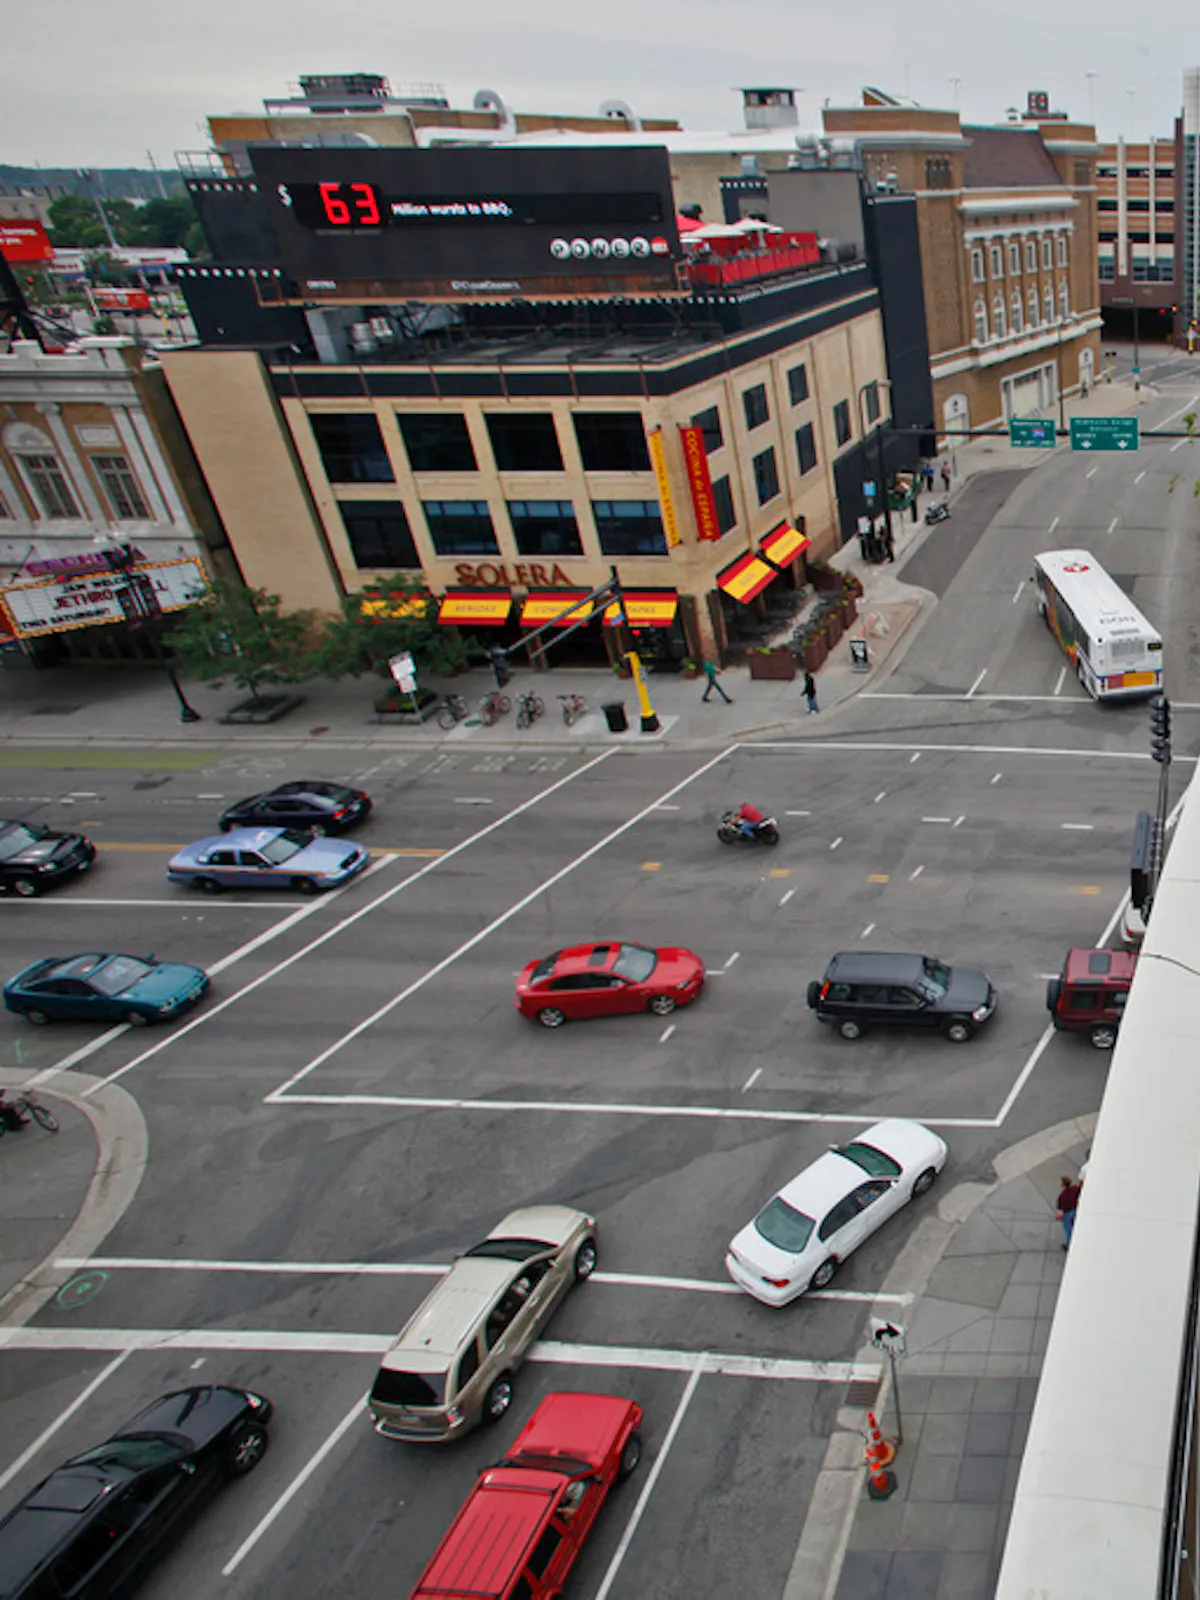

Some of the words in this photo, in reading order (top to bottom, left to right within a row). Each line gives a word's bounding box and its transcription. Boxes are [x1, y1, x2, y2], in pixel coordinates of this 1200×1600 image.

[319, 183, 381, 225] 63
[686, 430, 703, 477] COCINA
[454, 562, 575, 587] SOLERA
[54, 588, 114, 610] JETHRO
